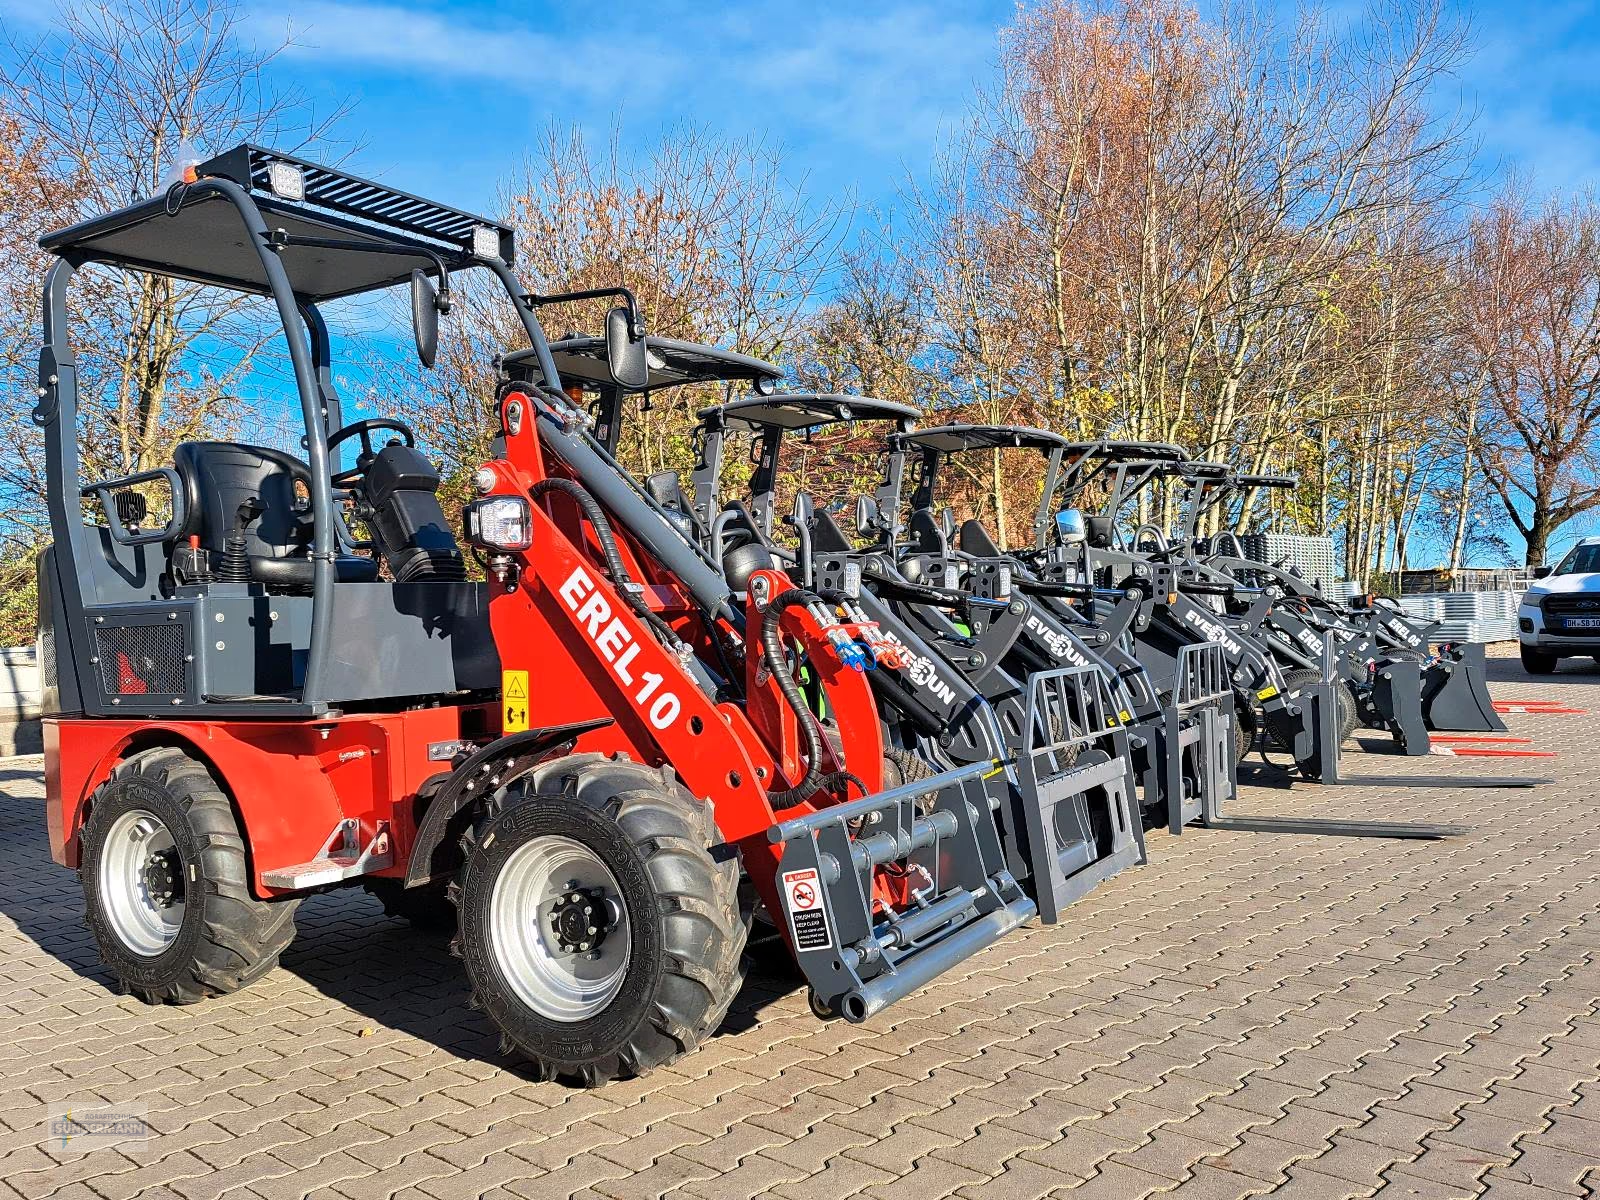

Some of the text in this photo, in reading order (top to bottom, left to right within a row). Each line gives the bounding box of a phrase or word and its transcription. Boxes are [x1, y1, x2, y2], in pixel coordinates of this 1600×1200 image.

[1297, 627, 1324, 657] EREL
[1387, 617, 1422, 647] EREL 05
[559, 565, 681, 730] EREL 10
